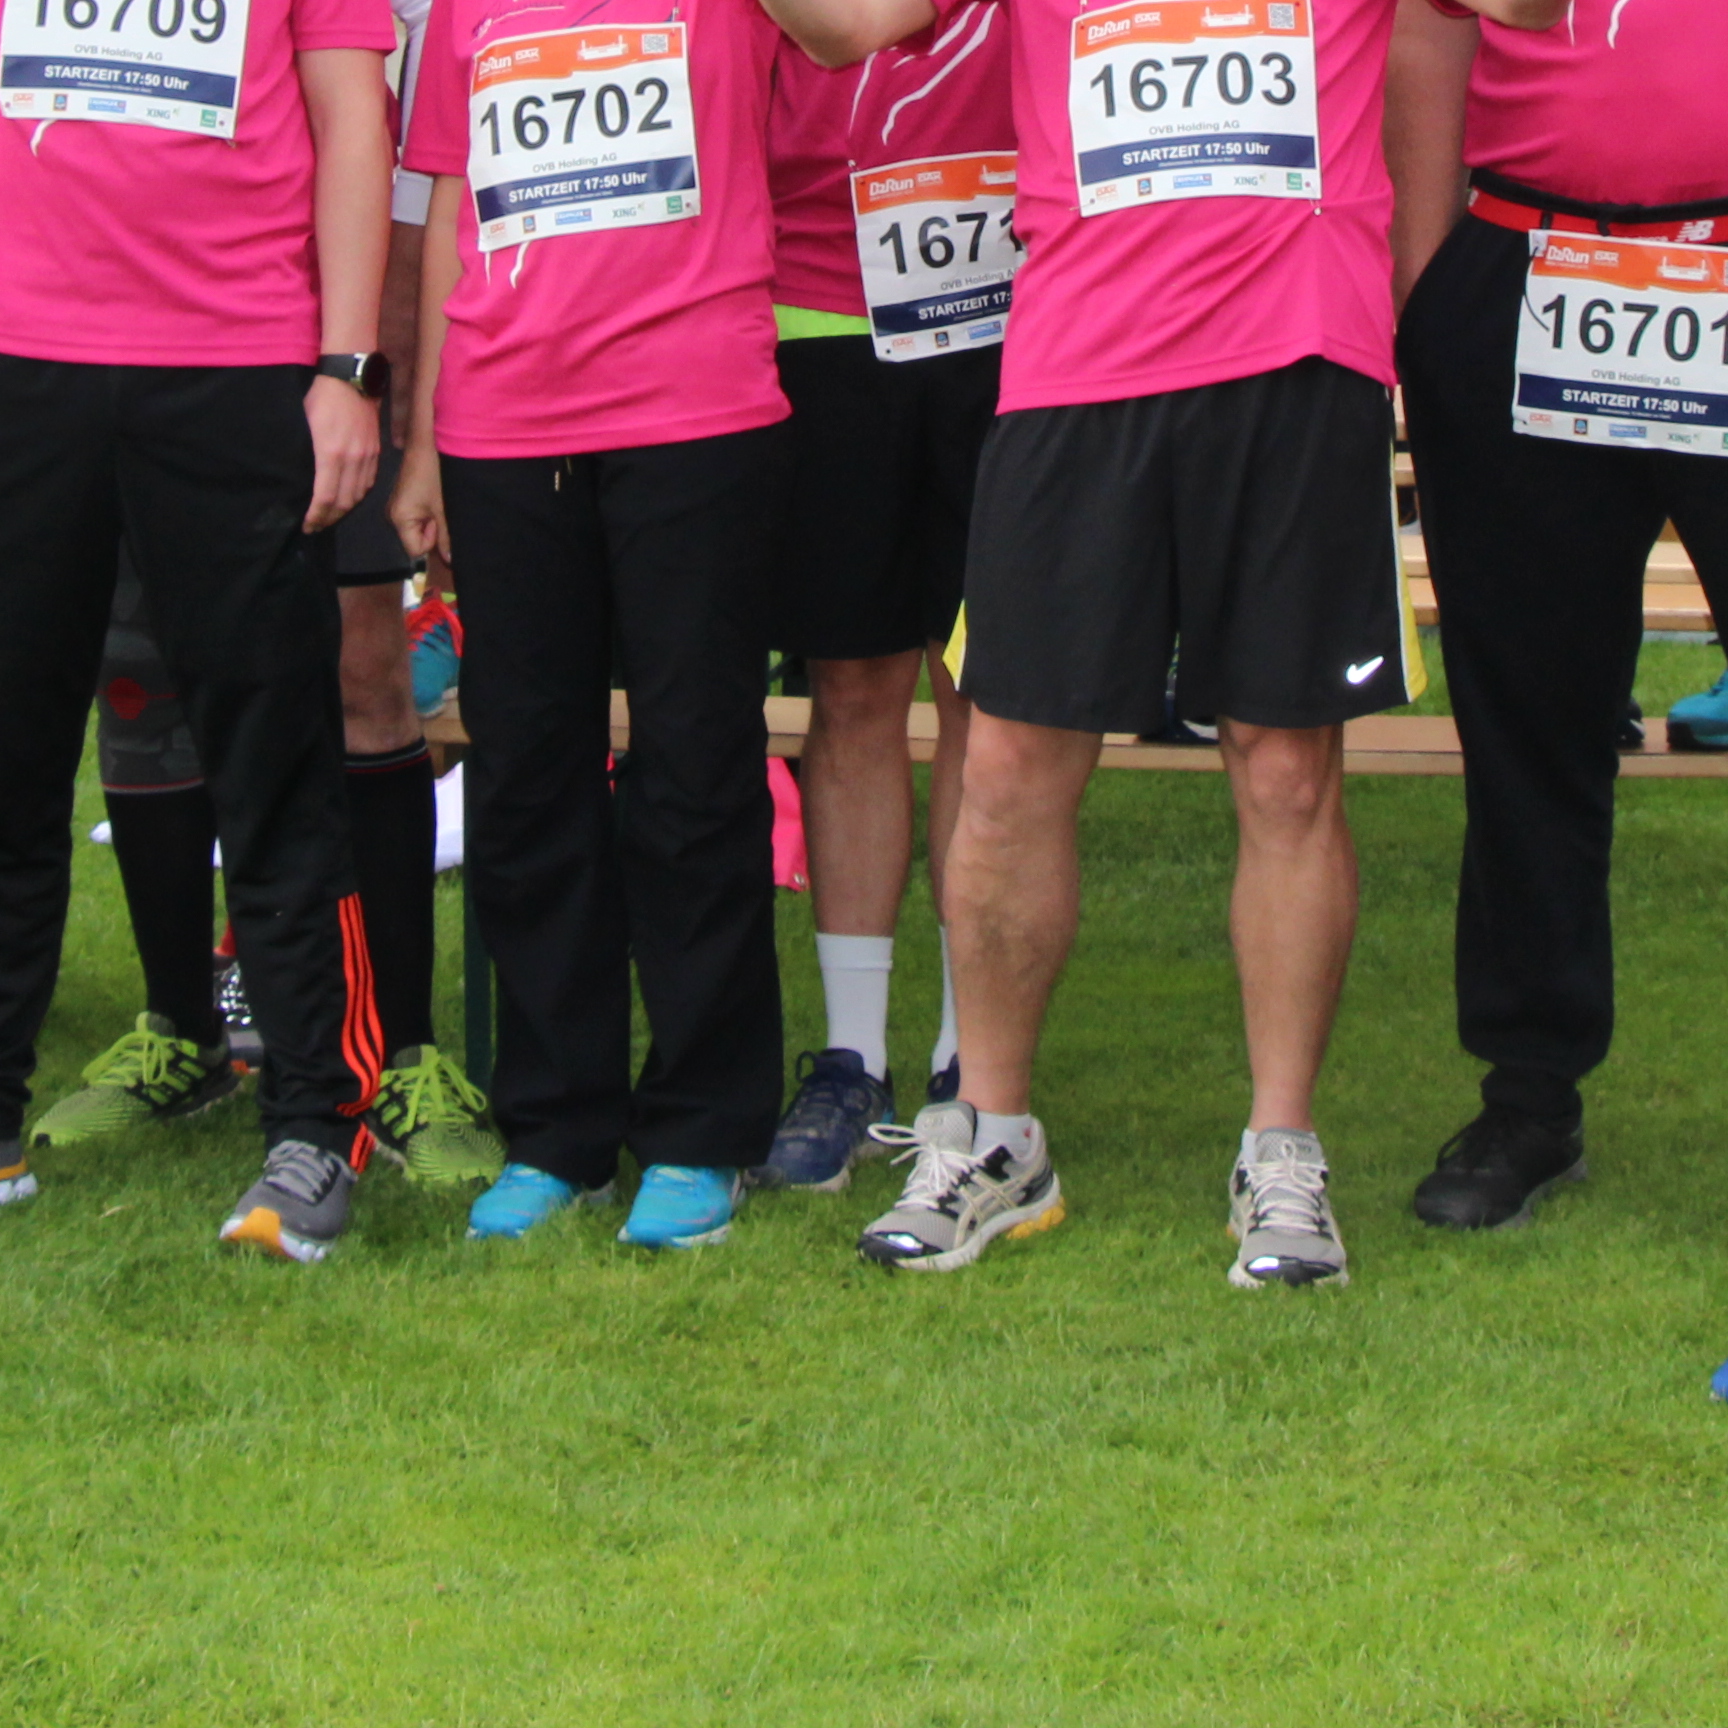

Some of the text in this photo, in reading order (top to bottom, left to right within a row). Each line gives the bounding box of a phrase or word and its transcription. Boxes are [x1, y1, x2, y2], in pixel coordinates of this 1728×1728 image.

[74, 44, 163, 62] OVB Holding AG
[44, 65, 121, 83] STARTZEIT
[124, 71, 161, 87] 17:50
[164, 76, 189, 91] Uhr
[1090, 51, 1297, 118] 16703
[480, 77, 672, 156] 16702
[1149, 120, 1240, 136] OVB Holding AG
[533, 153, 617, 173] OVB Holding AG
[1122, 144, 1201, 165] STARTZEIT
[1204, 142, 1242, 156] 17:50
[1244, 142, 1270, 156] Uhr
[509, 180, 581, 203] STARTZEIT
[583, 176, 620, 191] 17:50
[621, 172, 647, 186] Uhr
[1234, 175, 1258, 186] XING
[940, 278, 962, 291] OVB
[965, 268, 1005, 286] Holding
[918, 295, 989, 320] STARTZEIT
[992, 292, 1012, 306] 17:
[1591, 369, 1681, 386] OVB Holding AG
[1562, 388, 1640, 409] STARTZEIT
[1643, 395, 1679, 412] 17:50
[1682, 400, 1708, 414] Uhr
